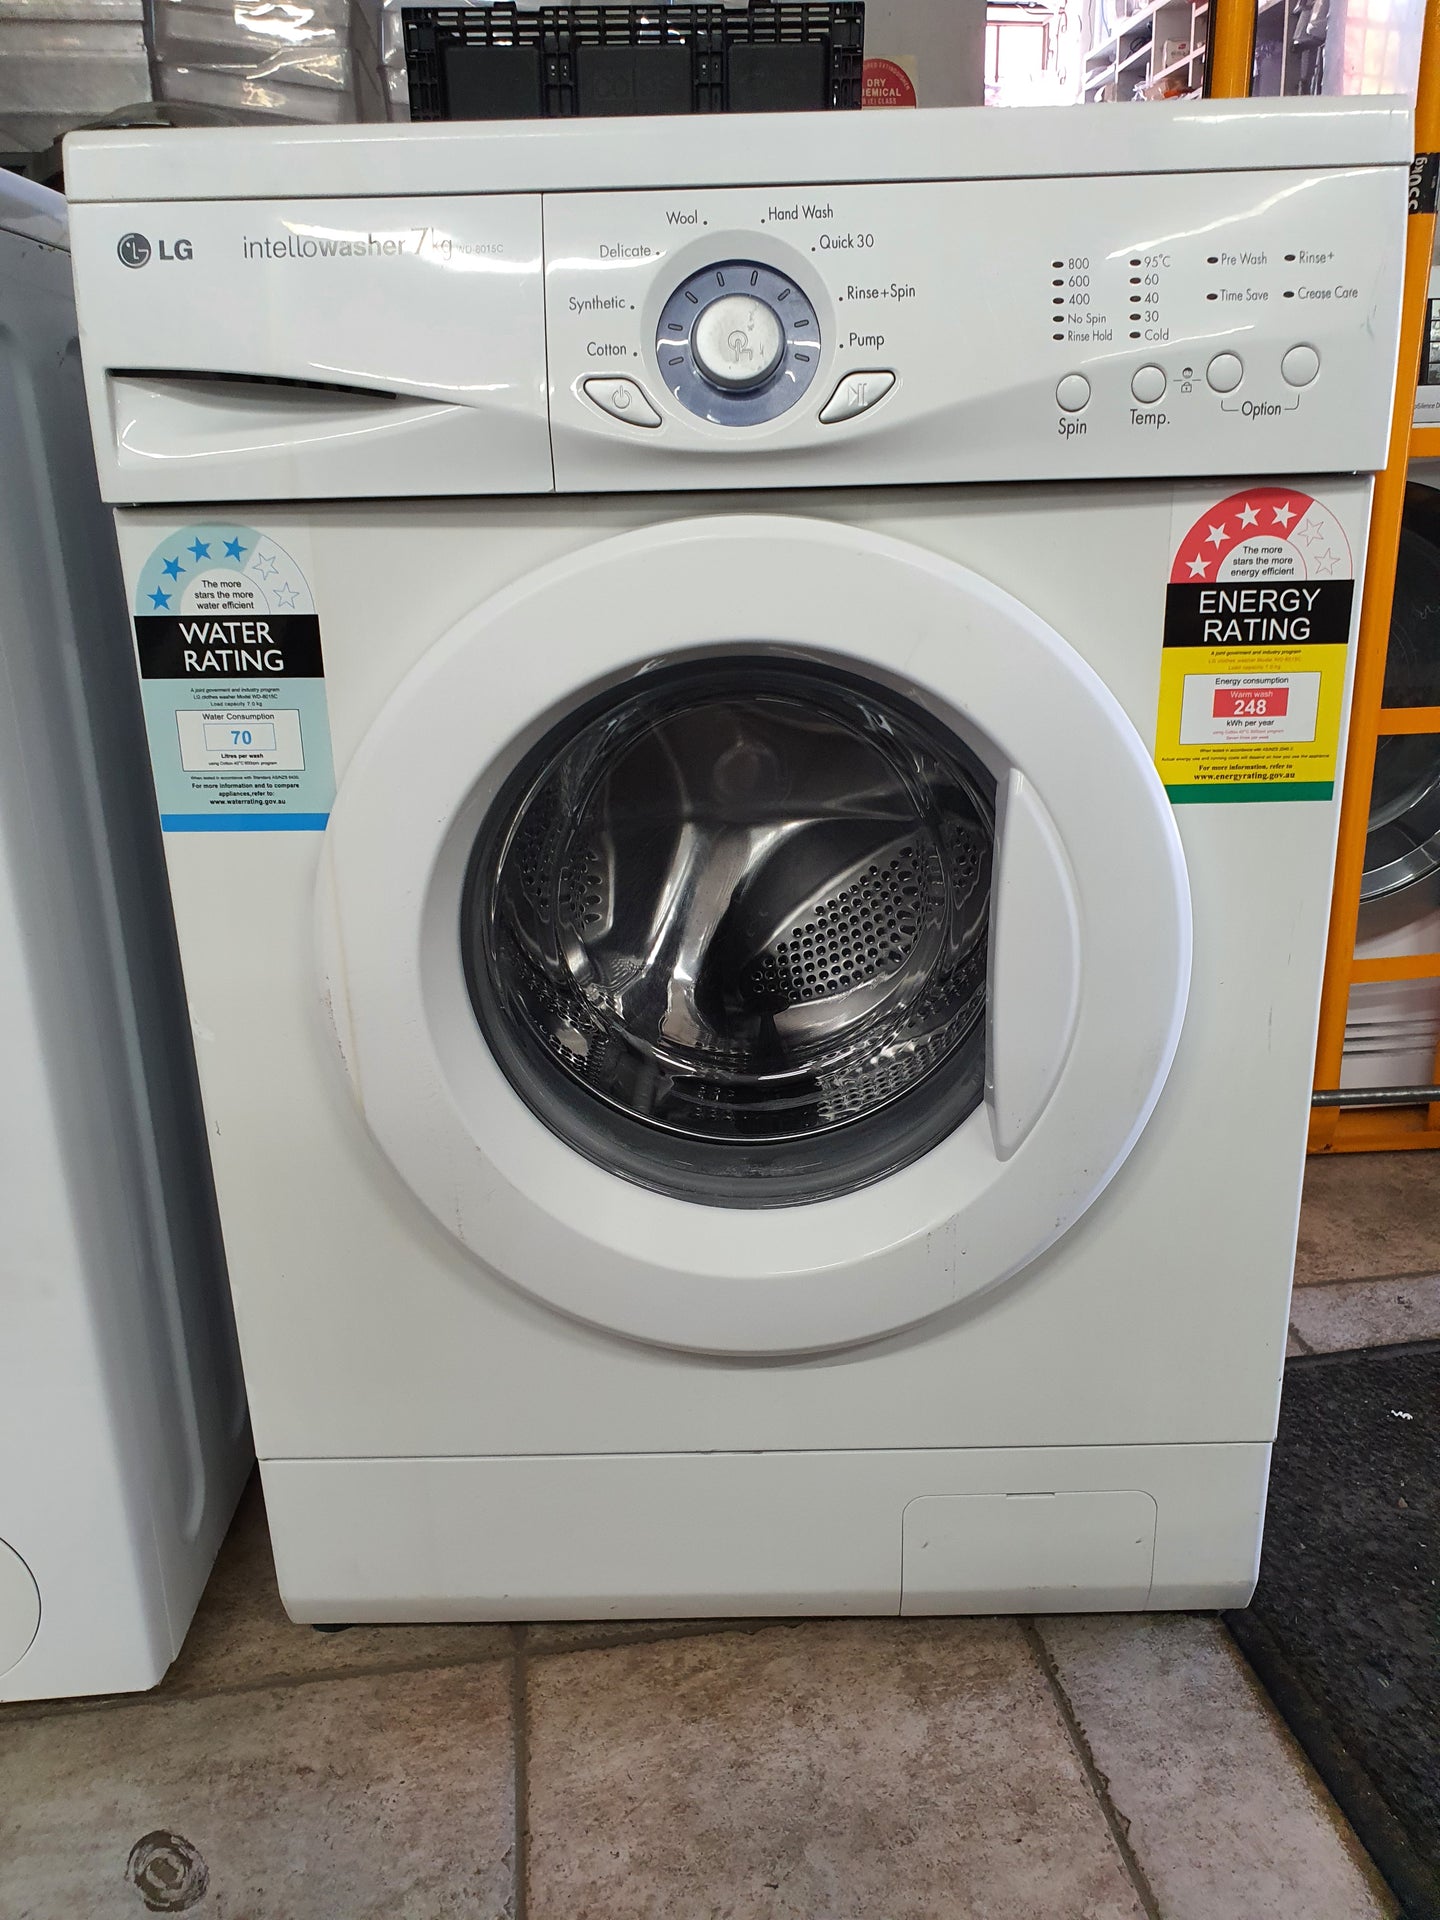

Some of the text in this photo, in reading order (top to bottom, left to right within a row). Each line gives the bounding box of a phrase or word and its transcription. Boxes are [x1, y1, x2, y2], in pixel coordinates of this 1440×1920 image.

[867, 79, 886, 87] DRY
[862, 88, 901, 96] EMICAL
[666, 210, 698, 225] Wool
[769, 203, 833, 221] Hand Wash
[243, 233, 406, 258] intellowasher
[820, 233, 874, 249] Quick 30
[159, 240, 193, 260] LG
[600, 243, 651, 258] Delicate
[1068, 258, 1089, 270] 800
[1144, 254, 1170, 268] 95°C
[1221, 252, 1267, 265] Pre Wash
[1299, 251, 1334, 264] Rinse+
[1068, 275, 1090, 287] 600
[1144, 274, 1159, 285] 60
[847, 284, 915, 302] Rinse+Spin
[1069, 294, 1090, 305] 400
[1144, 292, 1159, 304] 40
[1220, 288, 1268, 301] Time Save
[1298, 286, 1358, 299] Crease Care
[569, 295, 626, 315] Synthetic
[1068, 313, 1106, 327] No Spin
[1145, 310, 1159, 322] 30
[849, 332, 884, 350] Pump
[1068, 329, 1112, 341] Rinse Hold
[1145, 328, 1169, 341] Cold
[587, 342, 626, 357] Cotton
[1242, 401, 1281, 420] Option
[1130, 409, 1170, 429] Temp.
[1058, 418, 1087, 440] Spin
[1243, 546, 1258, 554] The
[1231, 567, 1294, 577] energy efficient
[201, 580, 218, 588] The
[222, 601, 254, 609] efficient
[1199, 588, 1321, 613] ENERGY
[179, 622, 274, 644] WATER
[1204, 618, 1310, 642] RATING
[184, 650, 284, 671] RATING
[1234, 699, 1267, 715] 248
[231, 730, 252, 745] 70
[1194, 772, 1295, 780] www.energyrating.gov.au
